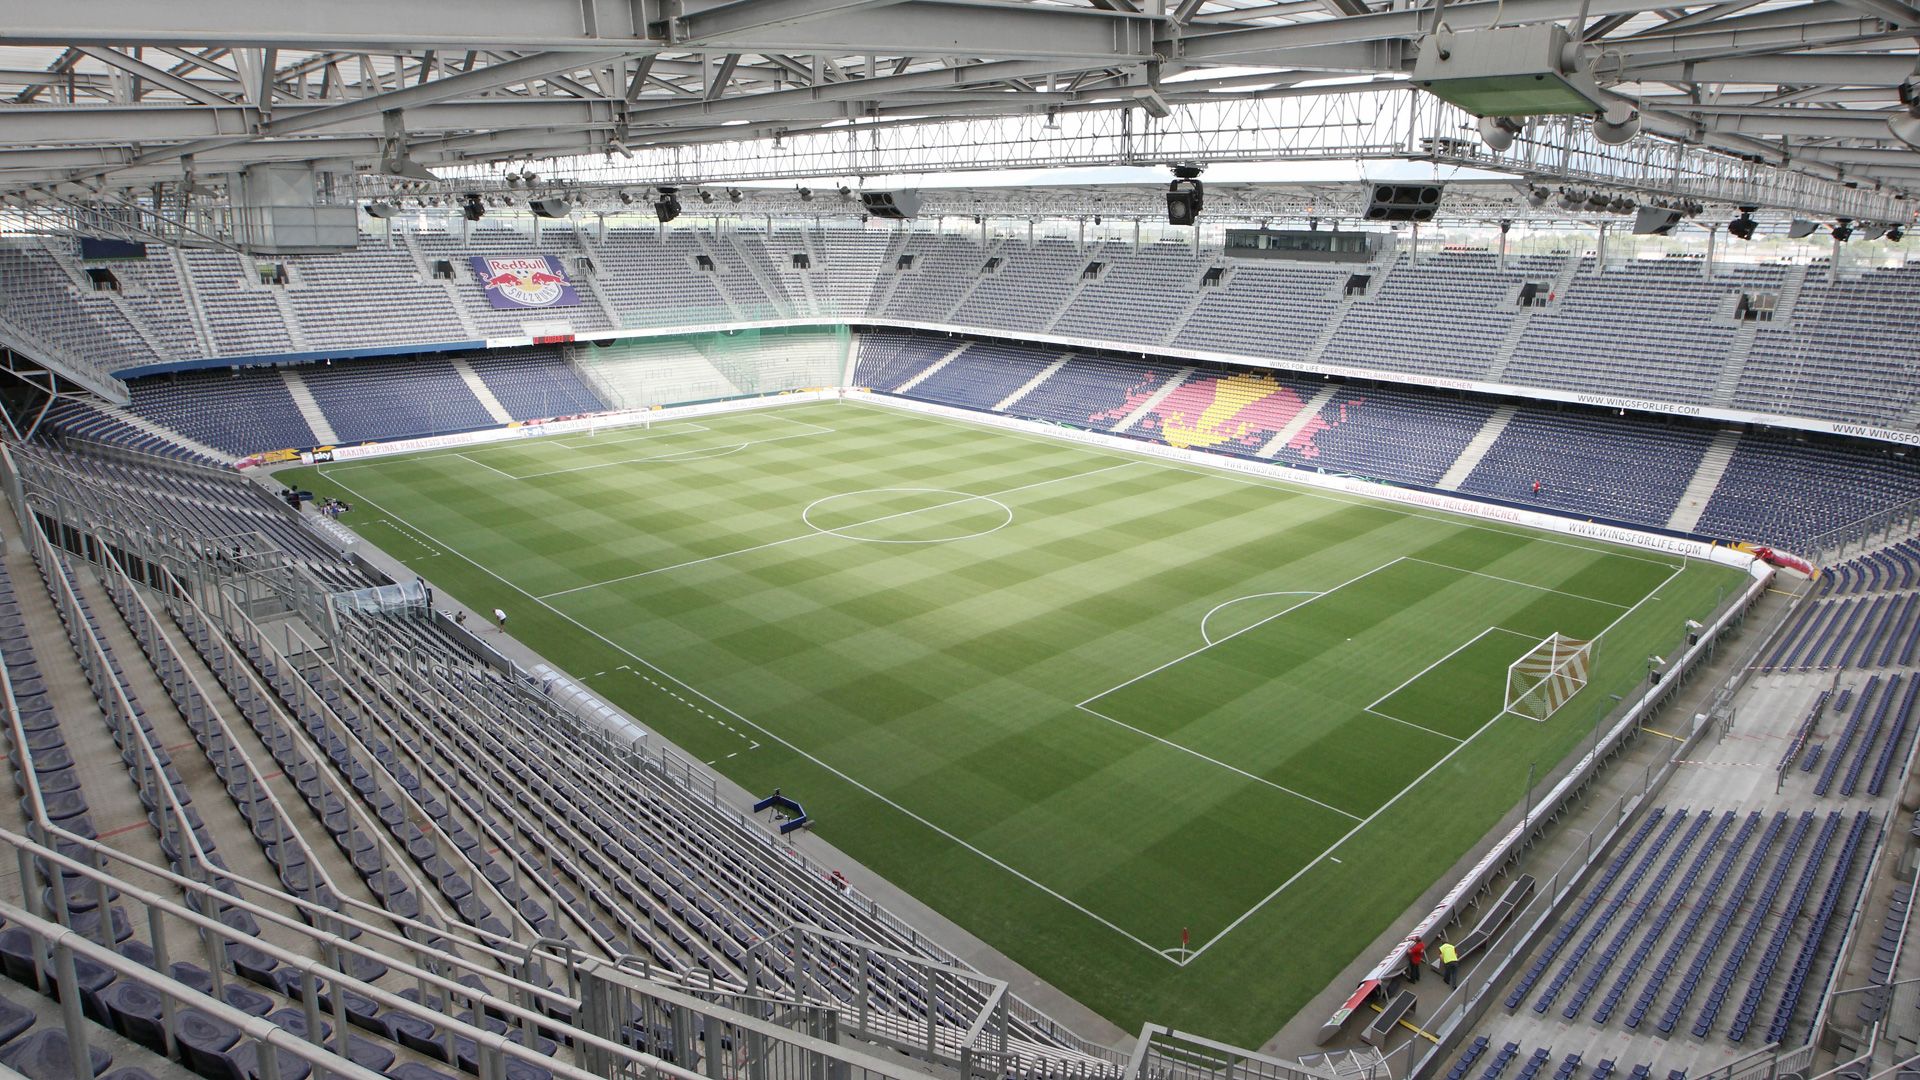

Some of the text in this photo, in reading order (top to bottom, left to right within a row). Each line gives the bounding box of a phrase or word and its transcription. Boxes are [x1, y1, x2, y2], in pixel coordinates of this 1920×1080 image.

[1270, 360, 1290, 369] WINGS
[1305, 364, 1319, 372] LIFE
[1440, 379, 1473, 389] MACHEN
[1577, 394, 1700, 415] WWW.WINGSFORLIFE.COM
[1832, 423, 1920, 444] WWW.WINGSFO
[314, 451, 331, 461] sky
[339, 447, 369, 457] MAKING
[372, 443, 399, 454] SPINAL
[401, 437, 441, 450] PARALYSIS
[1443, 497, 1480, 515] HEILBAR
[1568, 522, 1703, 556] WWW.WINGSFORLIFE.COM
